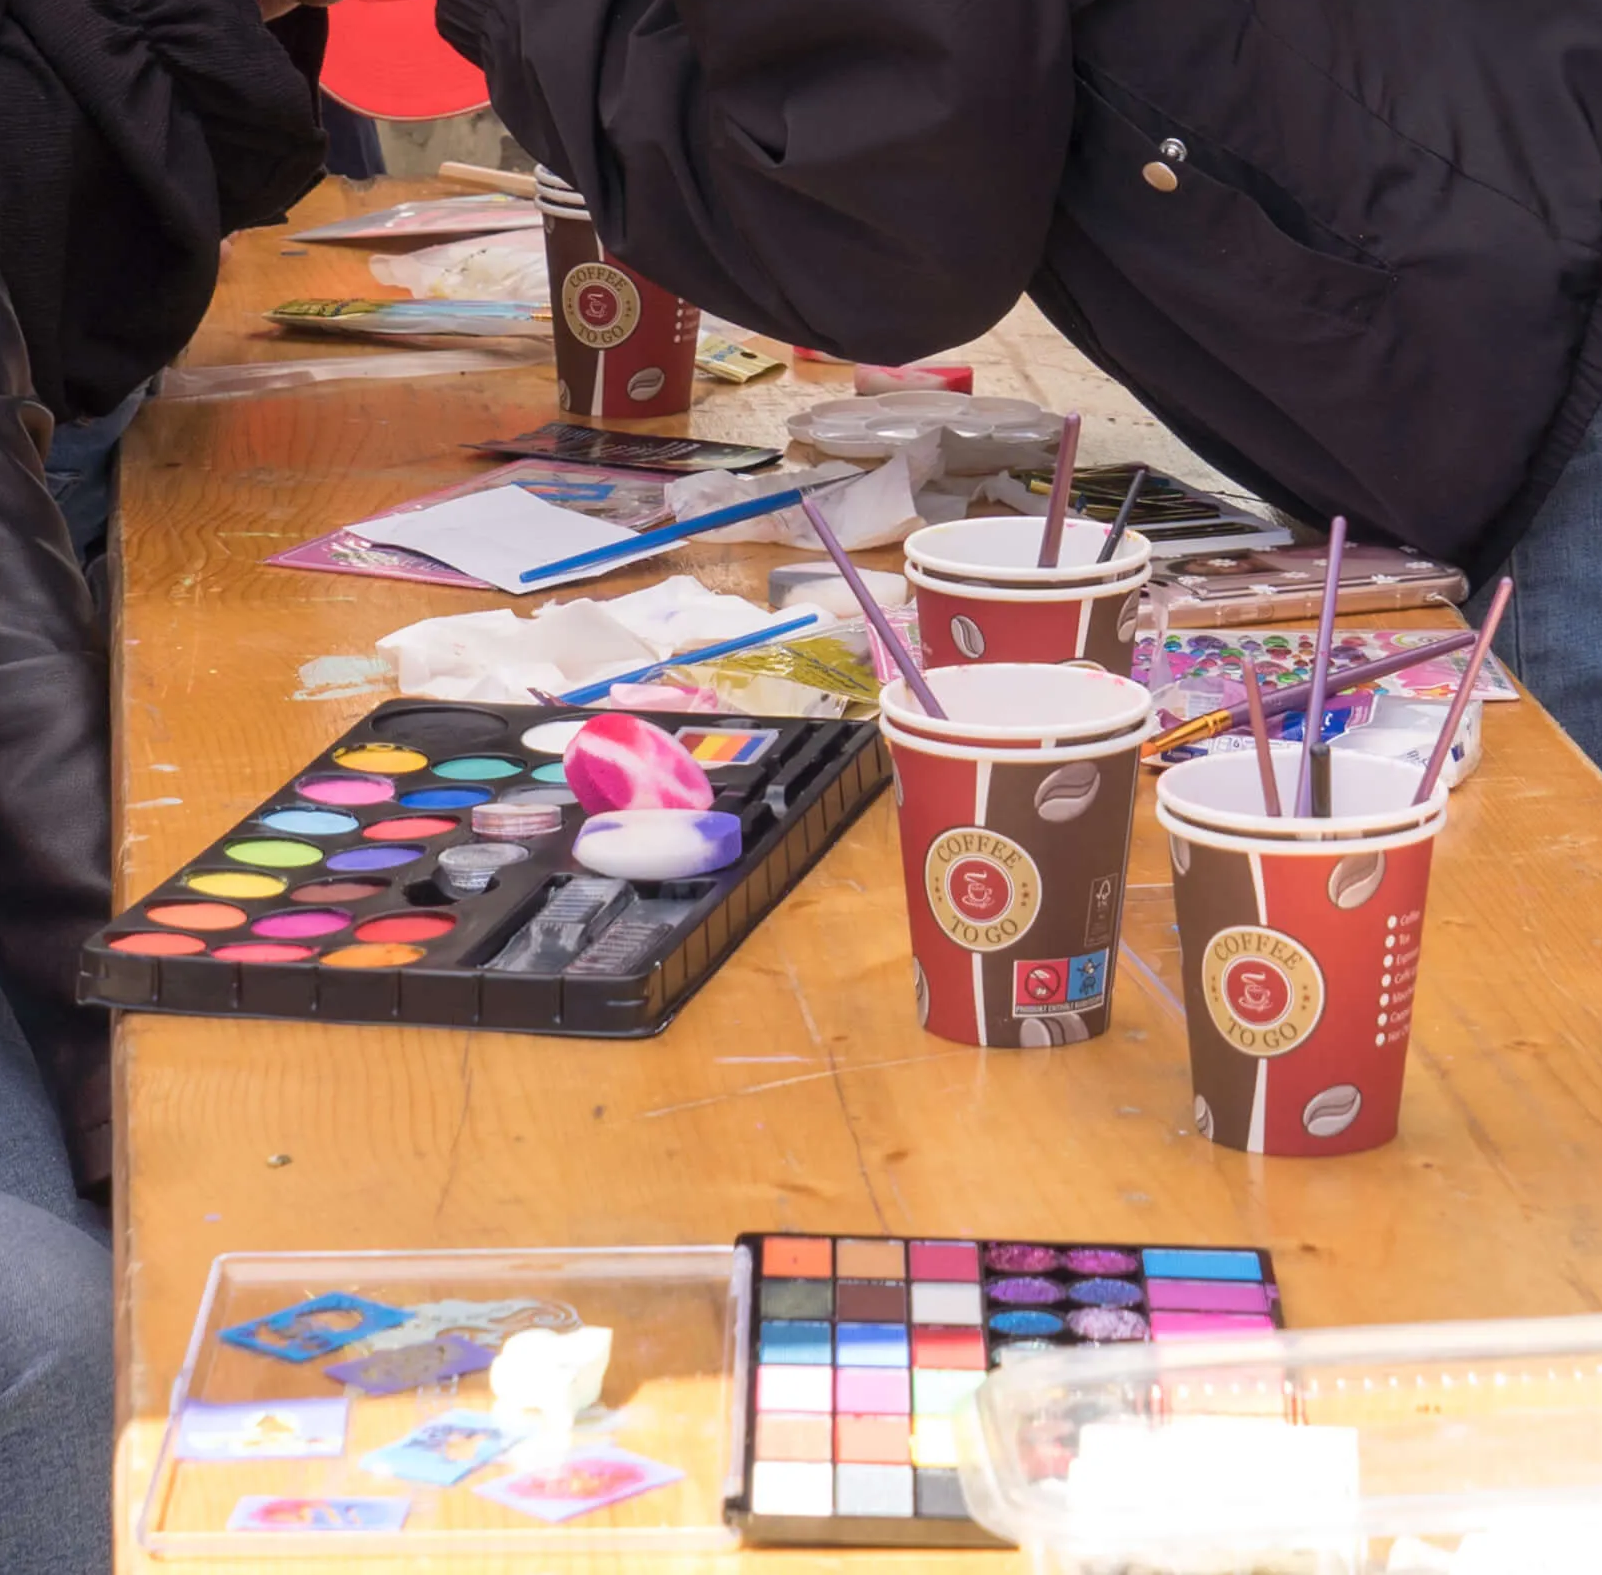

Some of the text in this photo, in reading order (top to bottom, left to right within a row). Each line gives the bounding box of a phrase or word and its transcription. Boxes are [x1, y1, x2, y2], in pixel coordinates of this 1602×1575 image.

[569, 265, 628, 292] COFFEE
[579, 324, 625, 343] TO GO
[936, 833, 1022, 870] COFFEE
[951, 914, 1018, 944] TO GO
[1214, 932, 1303, 971] COFFEE
[1227, 1015, 1298, 1049] TO GO
